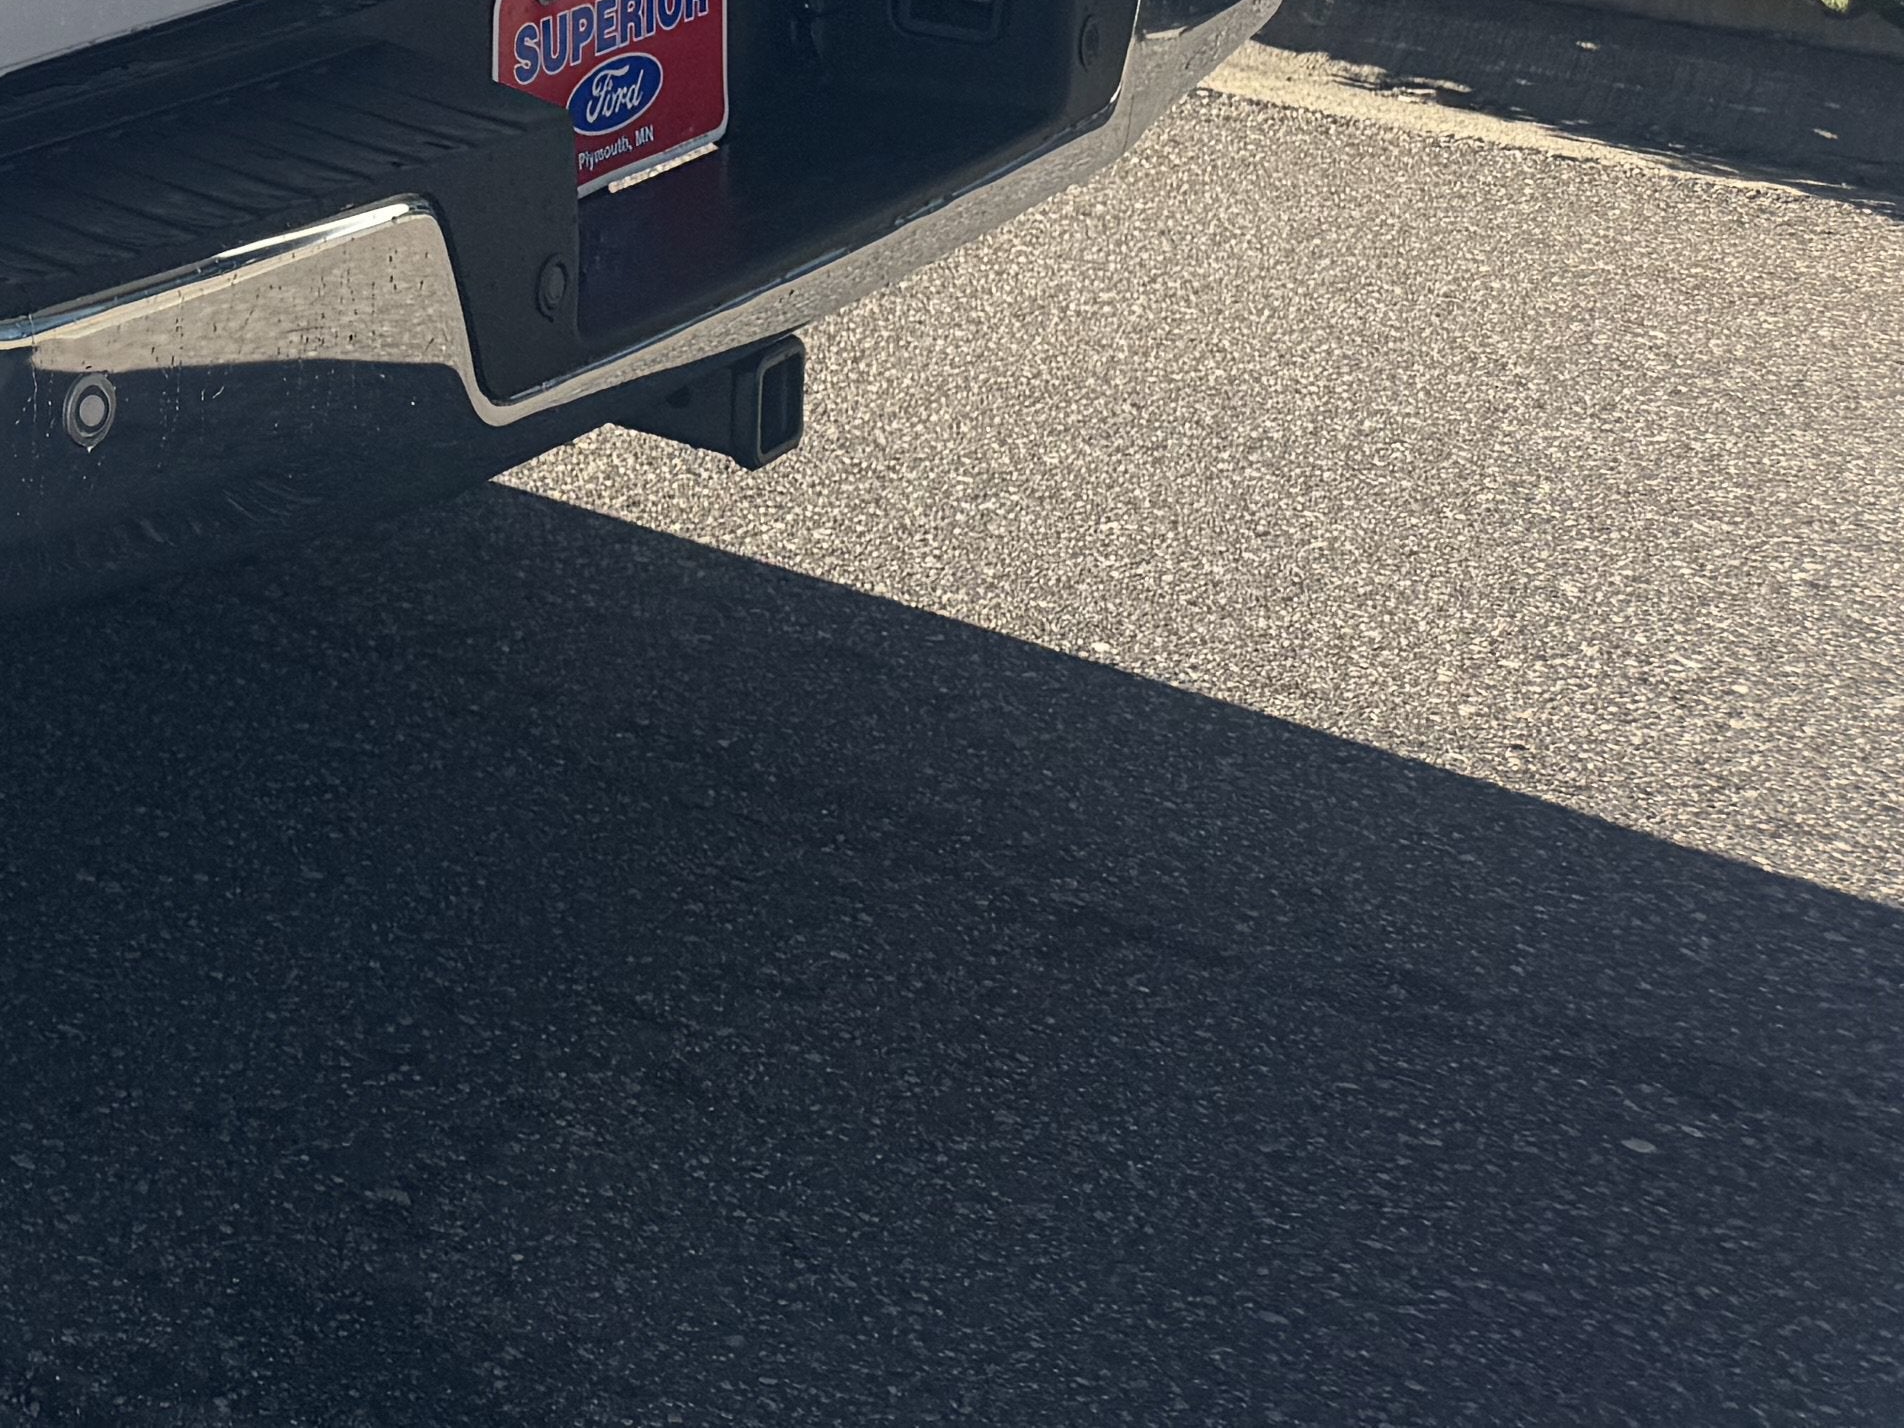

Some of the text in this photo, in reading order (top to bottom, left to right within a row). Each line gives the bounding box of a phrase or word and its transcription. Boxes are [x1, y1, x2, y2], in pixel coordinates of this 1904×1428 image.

[586, 65, 645, 124] Ford
[578, 124, 655, 171] Plymouth, MN
